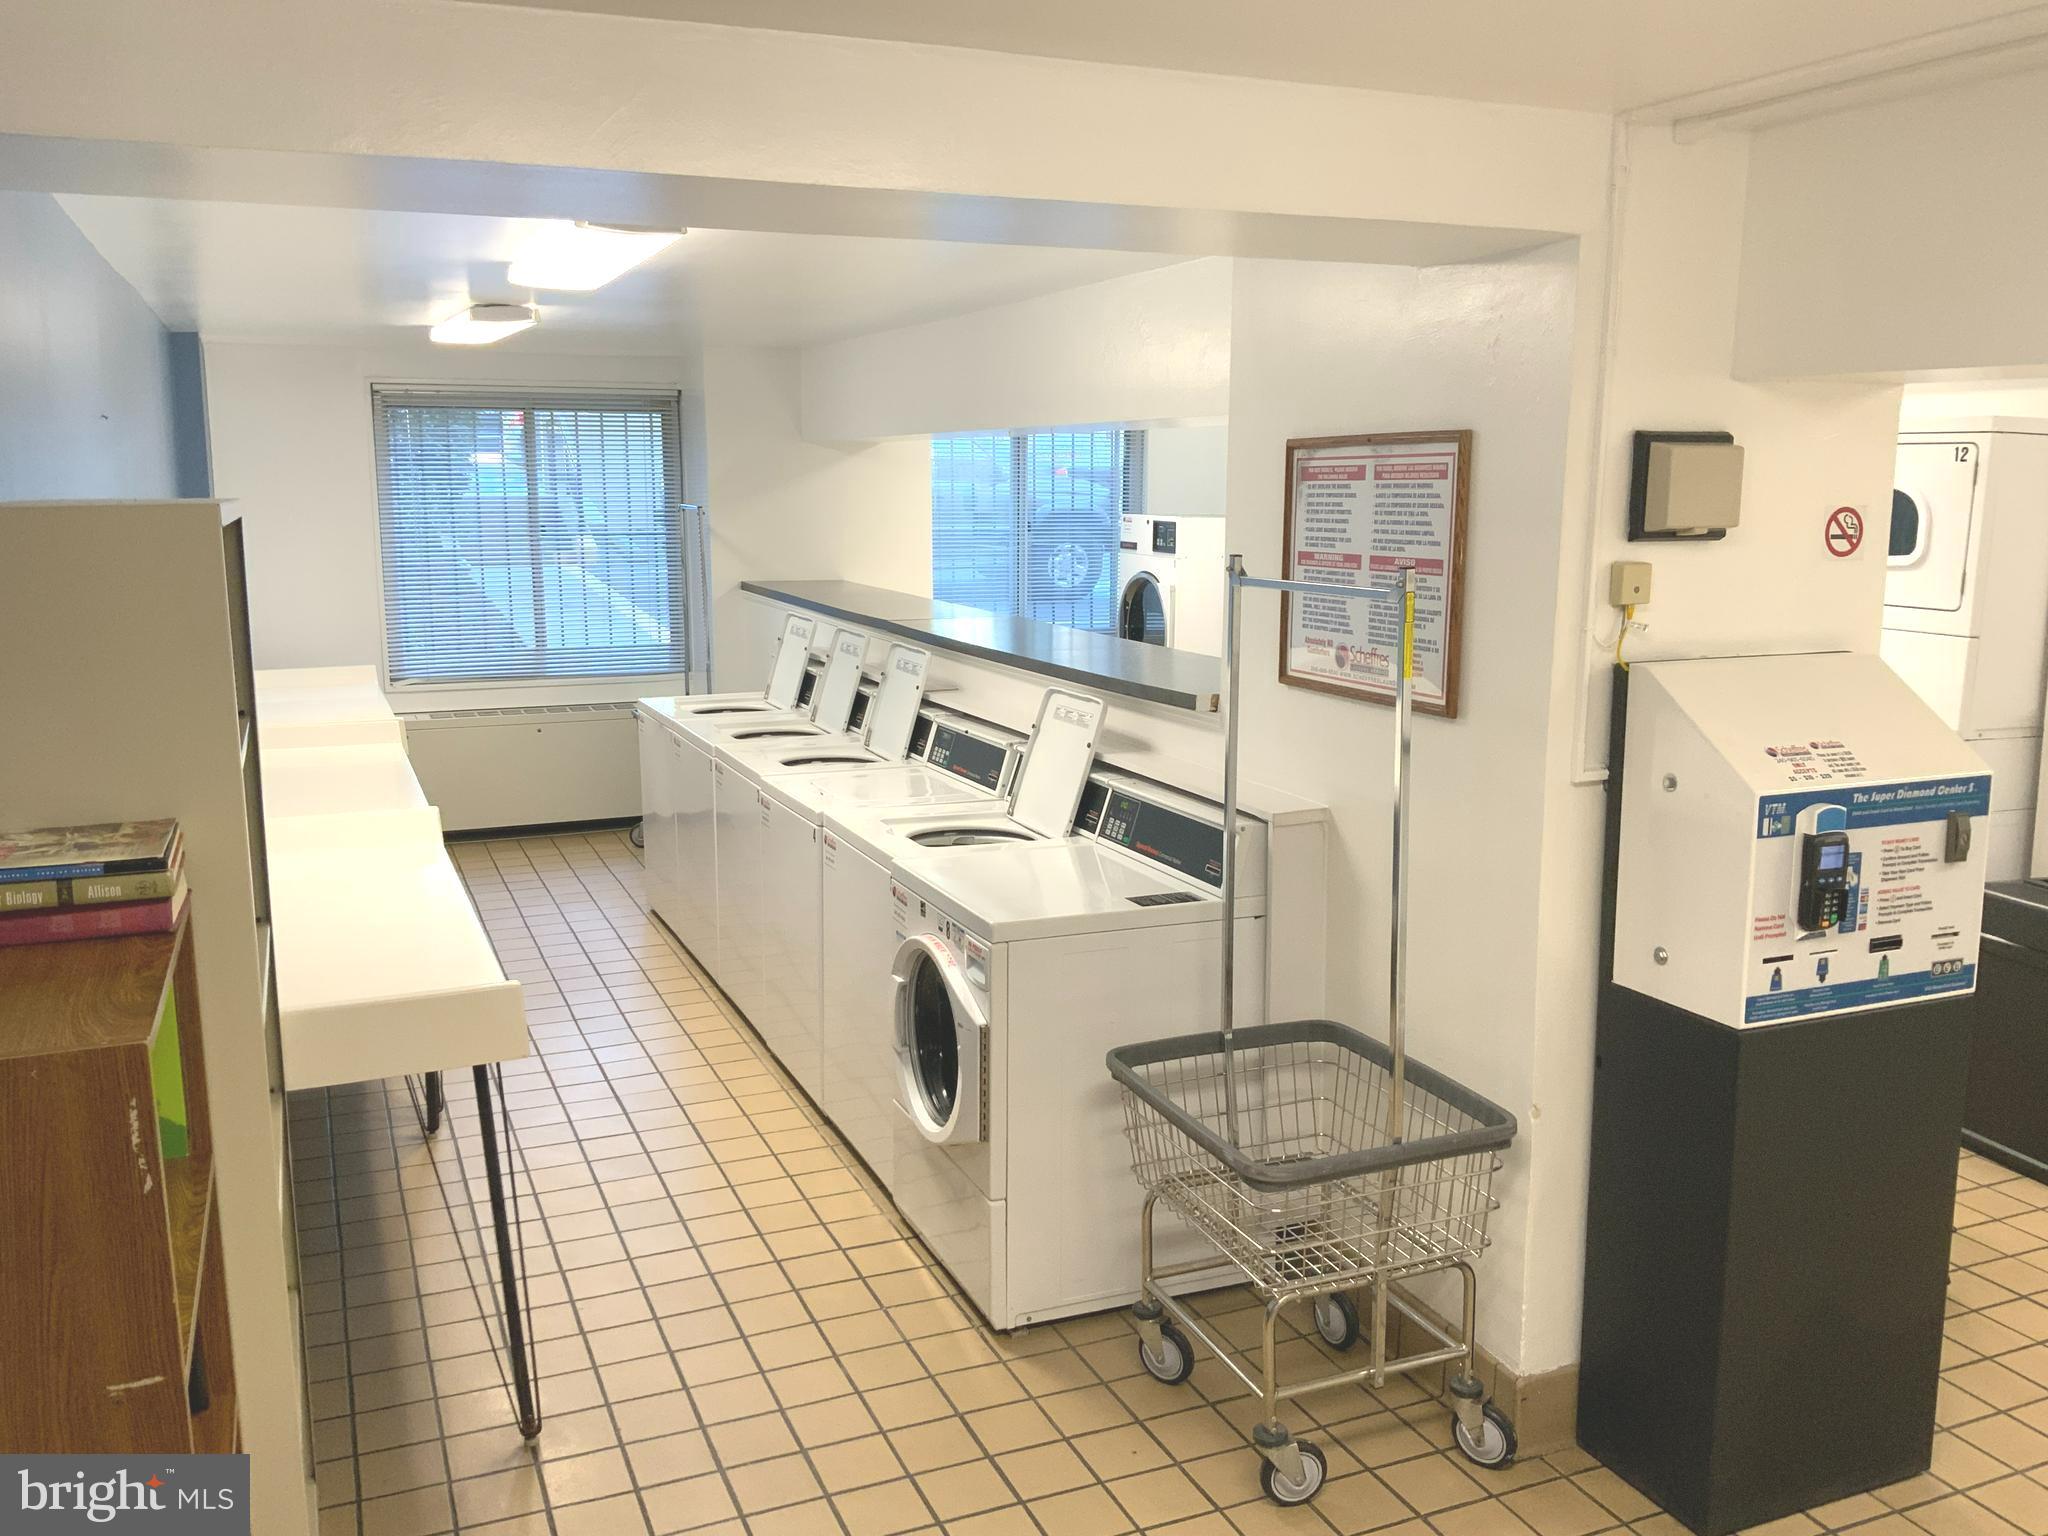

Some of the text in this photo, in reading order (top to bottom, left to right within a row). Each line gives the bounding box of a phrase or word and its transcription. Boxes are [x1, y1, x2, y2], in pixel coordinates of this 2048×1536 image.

[1955, 447, 1969, 462] 12
[1313, 553, 1344, 561] WARNING
[1394, 558, 1416, 566] AVISO
[1350, 645, 1390, 668] Scheffres
[1853, 792, 1868, 804] The
[1870, 791, 1895, 803] Super
[1896, 786, 1937, 800] Diamond
[1937, 783, 1967, 796] Center
[1765, 802, 1787, 816] VTM
[6, 891, 43, 905] Biology
[88, 885, 122, 899] Allison
